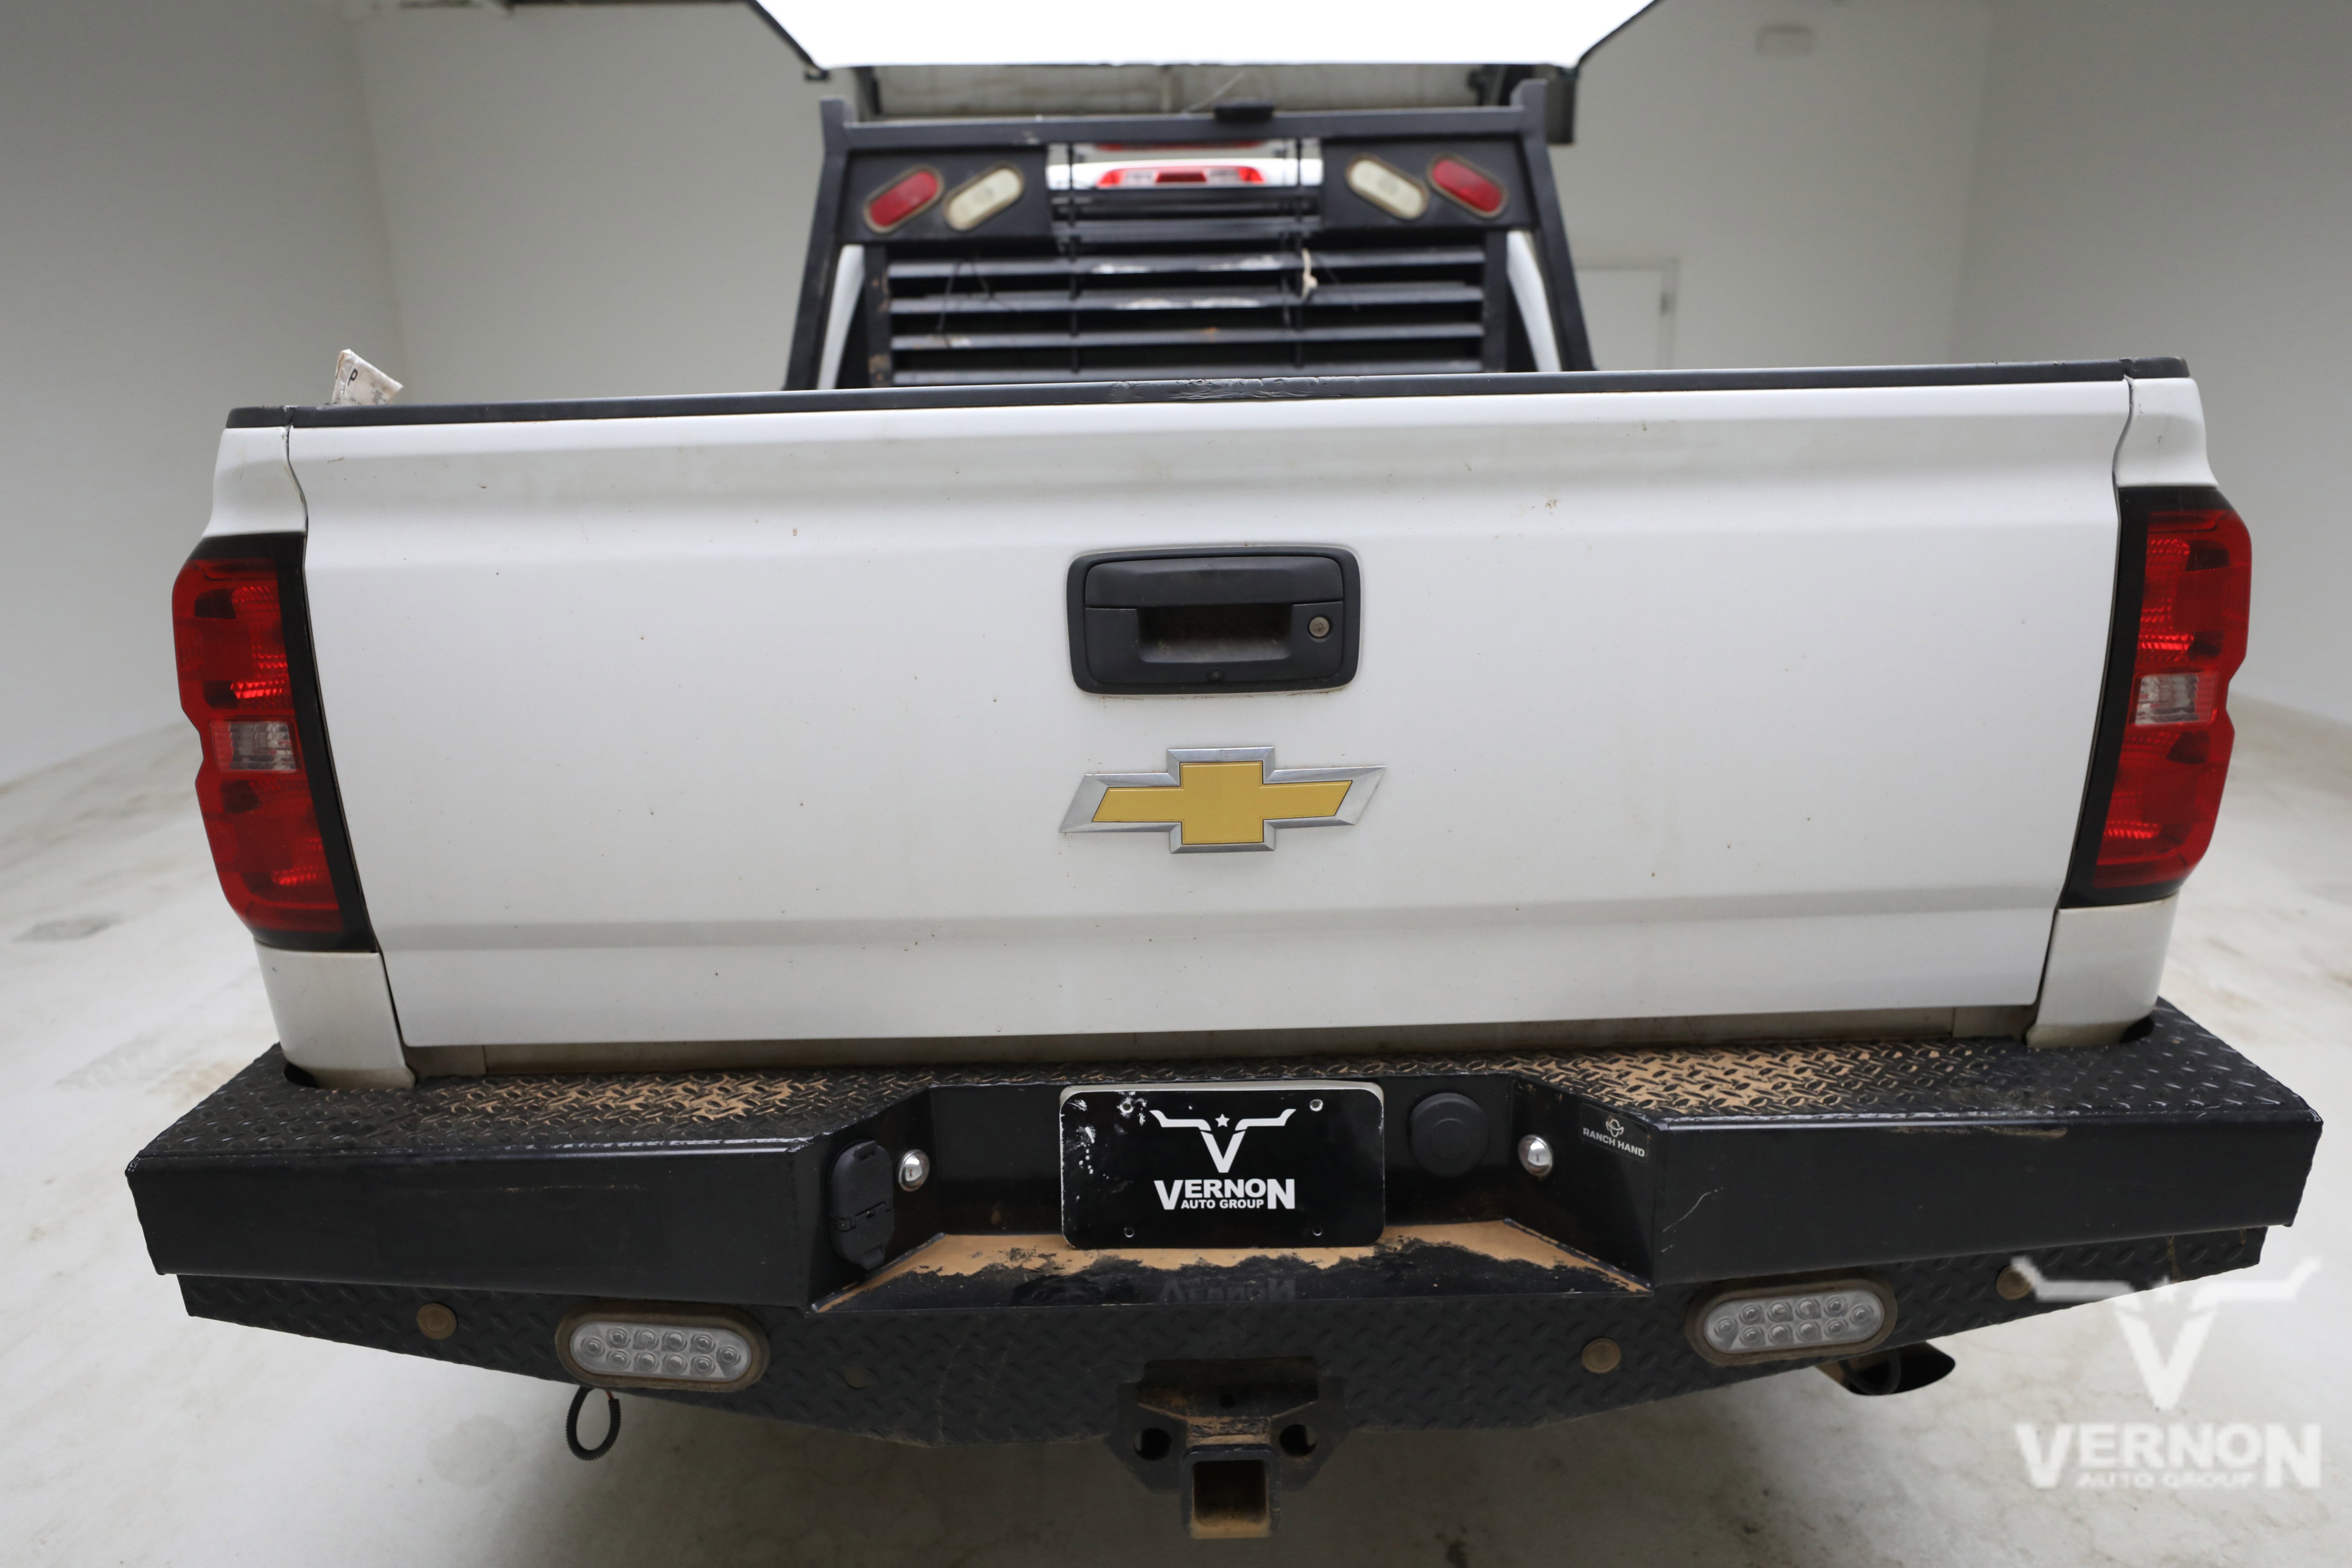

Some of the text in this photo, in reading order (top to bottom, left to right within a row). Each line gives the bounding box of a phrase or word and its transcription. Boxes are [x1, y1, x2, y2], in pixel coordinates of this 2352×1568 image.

[1583, 1127, 1646, 1158] RANCH HAND
[1154, 1178, 1295, 1210] VERNON
[1181, 1199, 1264, 1209] AUTO GROUP
